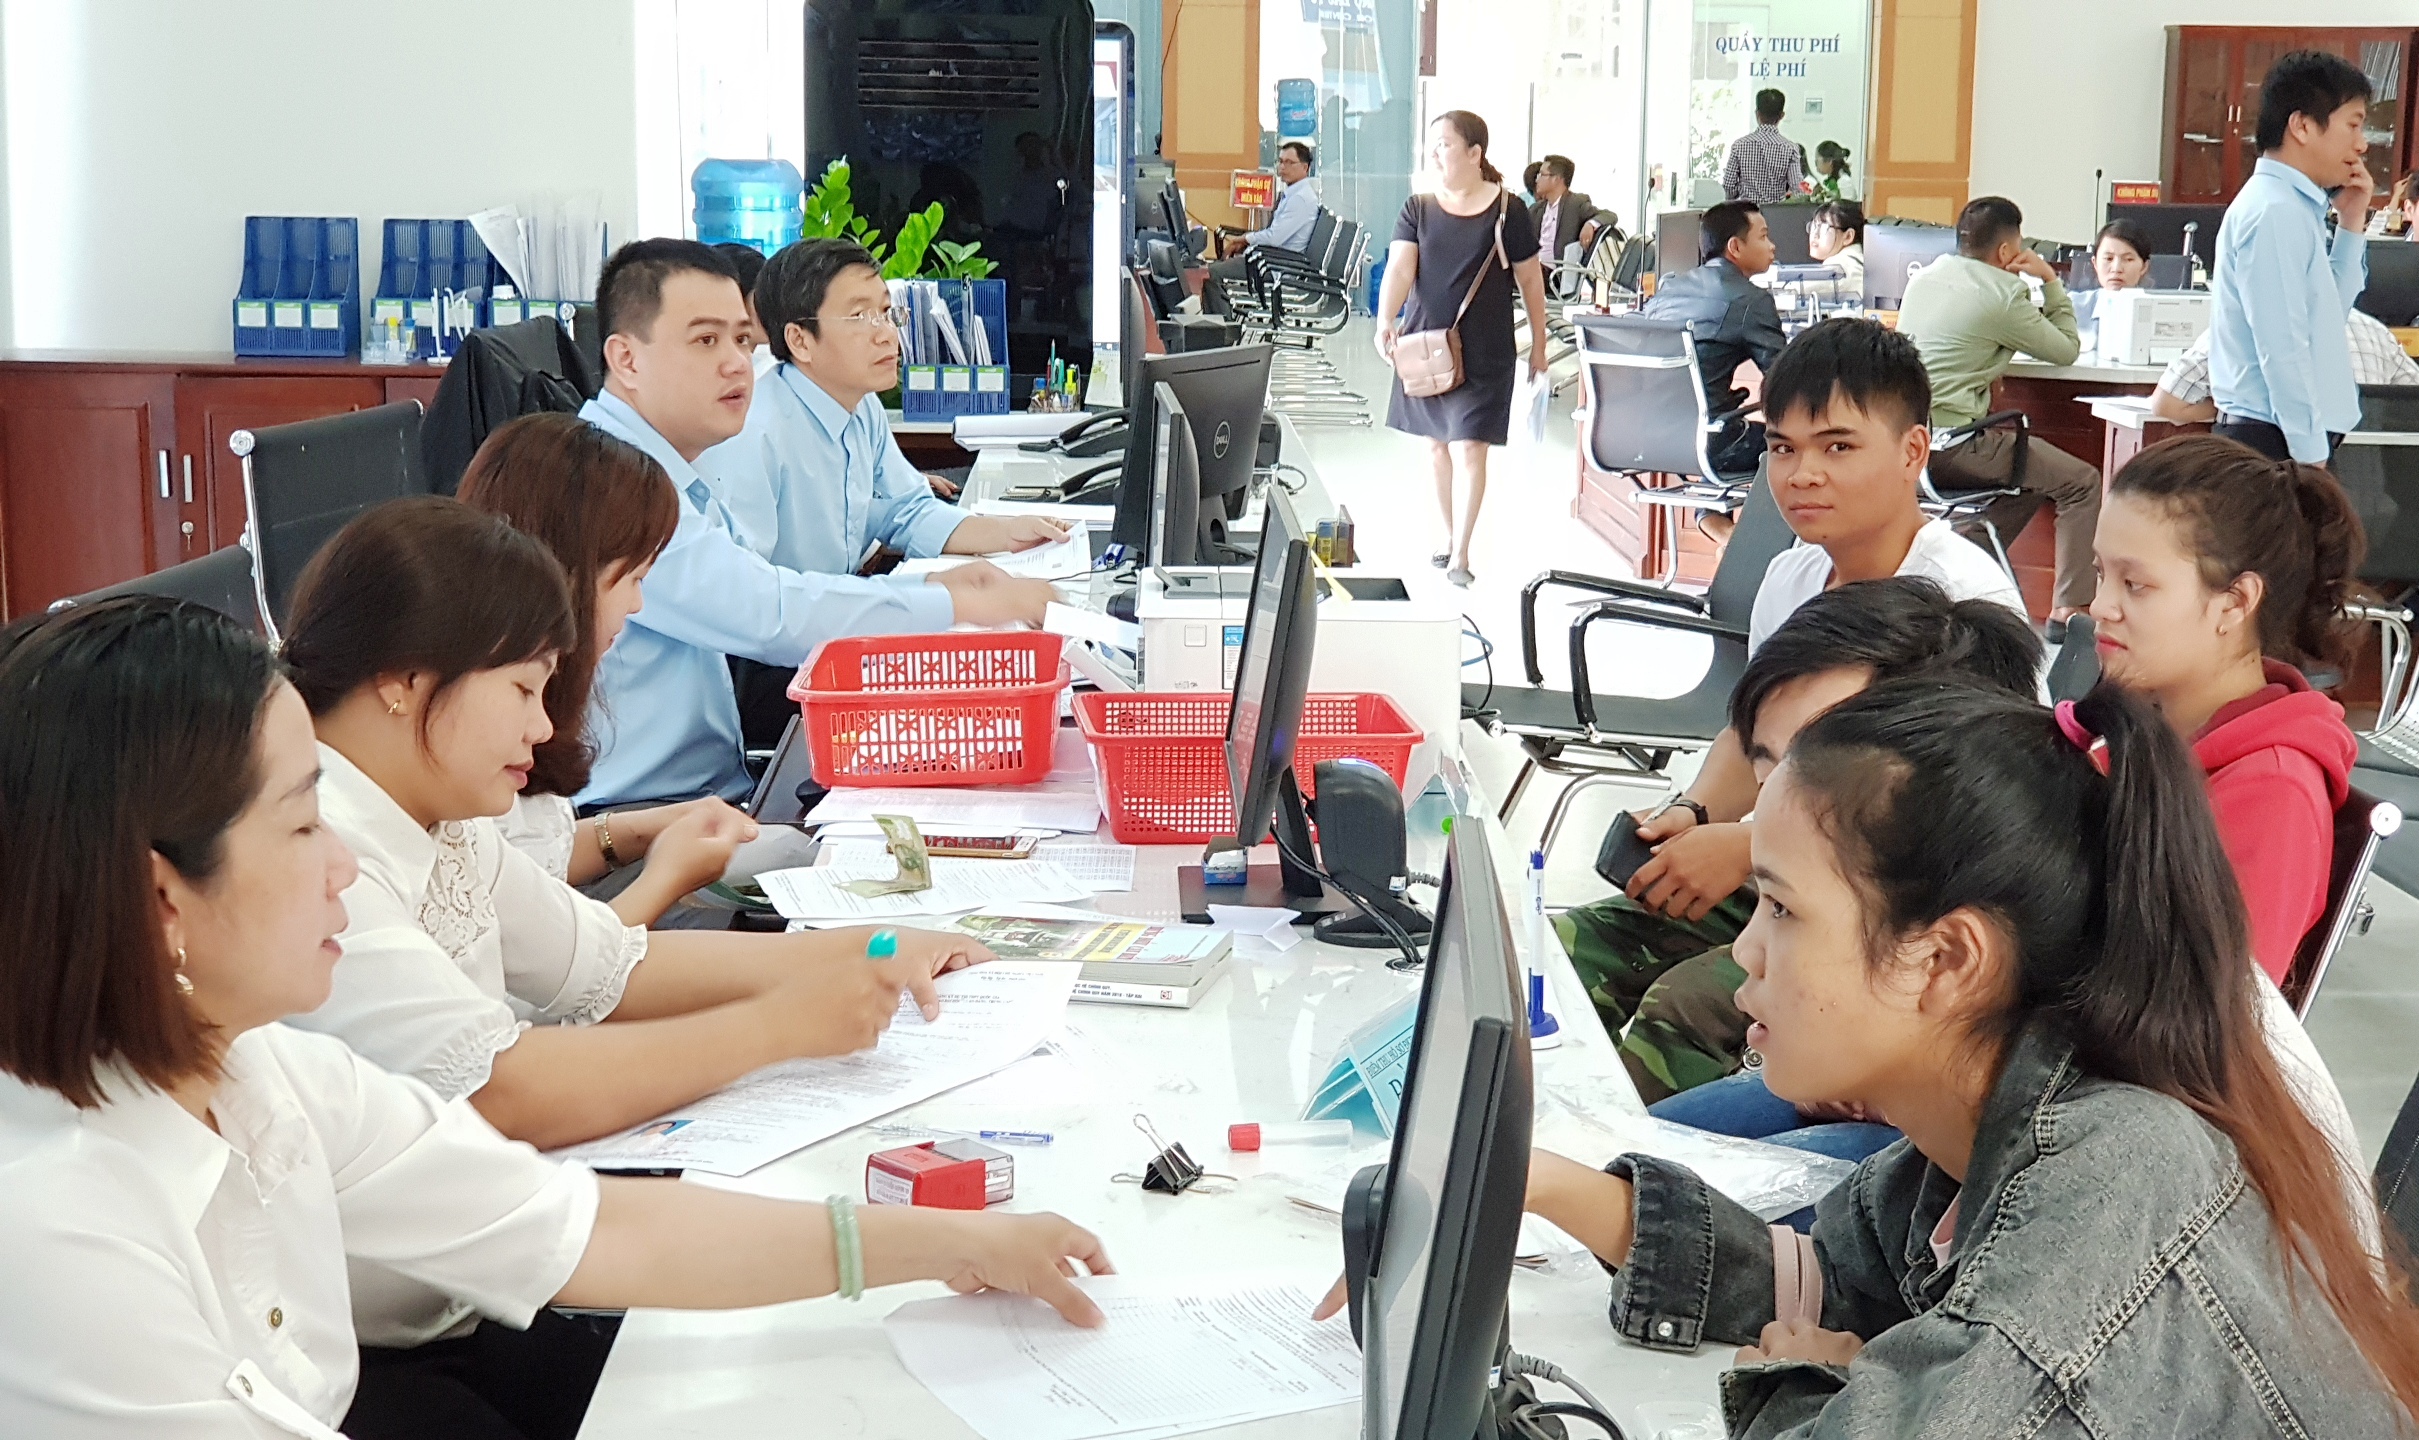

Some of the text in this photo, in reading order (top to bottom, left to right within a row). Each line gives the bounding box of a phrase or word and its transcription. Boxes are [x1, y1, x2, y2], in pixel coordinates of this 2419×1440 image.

[1769, 37, 1804, 52] THU
[1809, 33, 1840, 53] PHÍ
[1749, 58, 1807, 80] LỆ PHÍ
